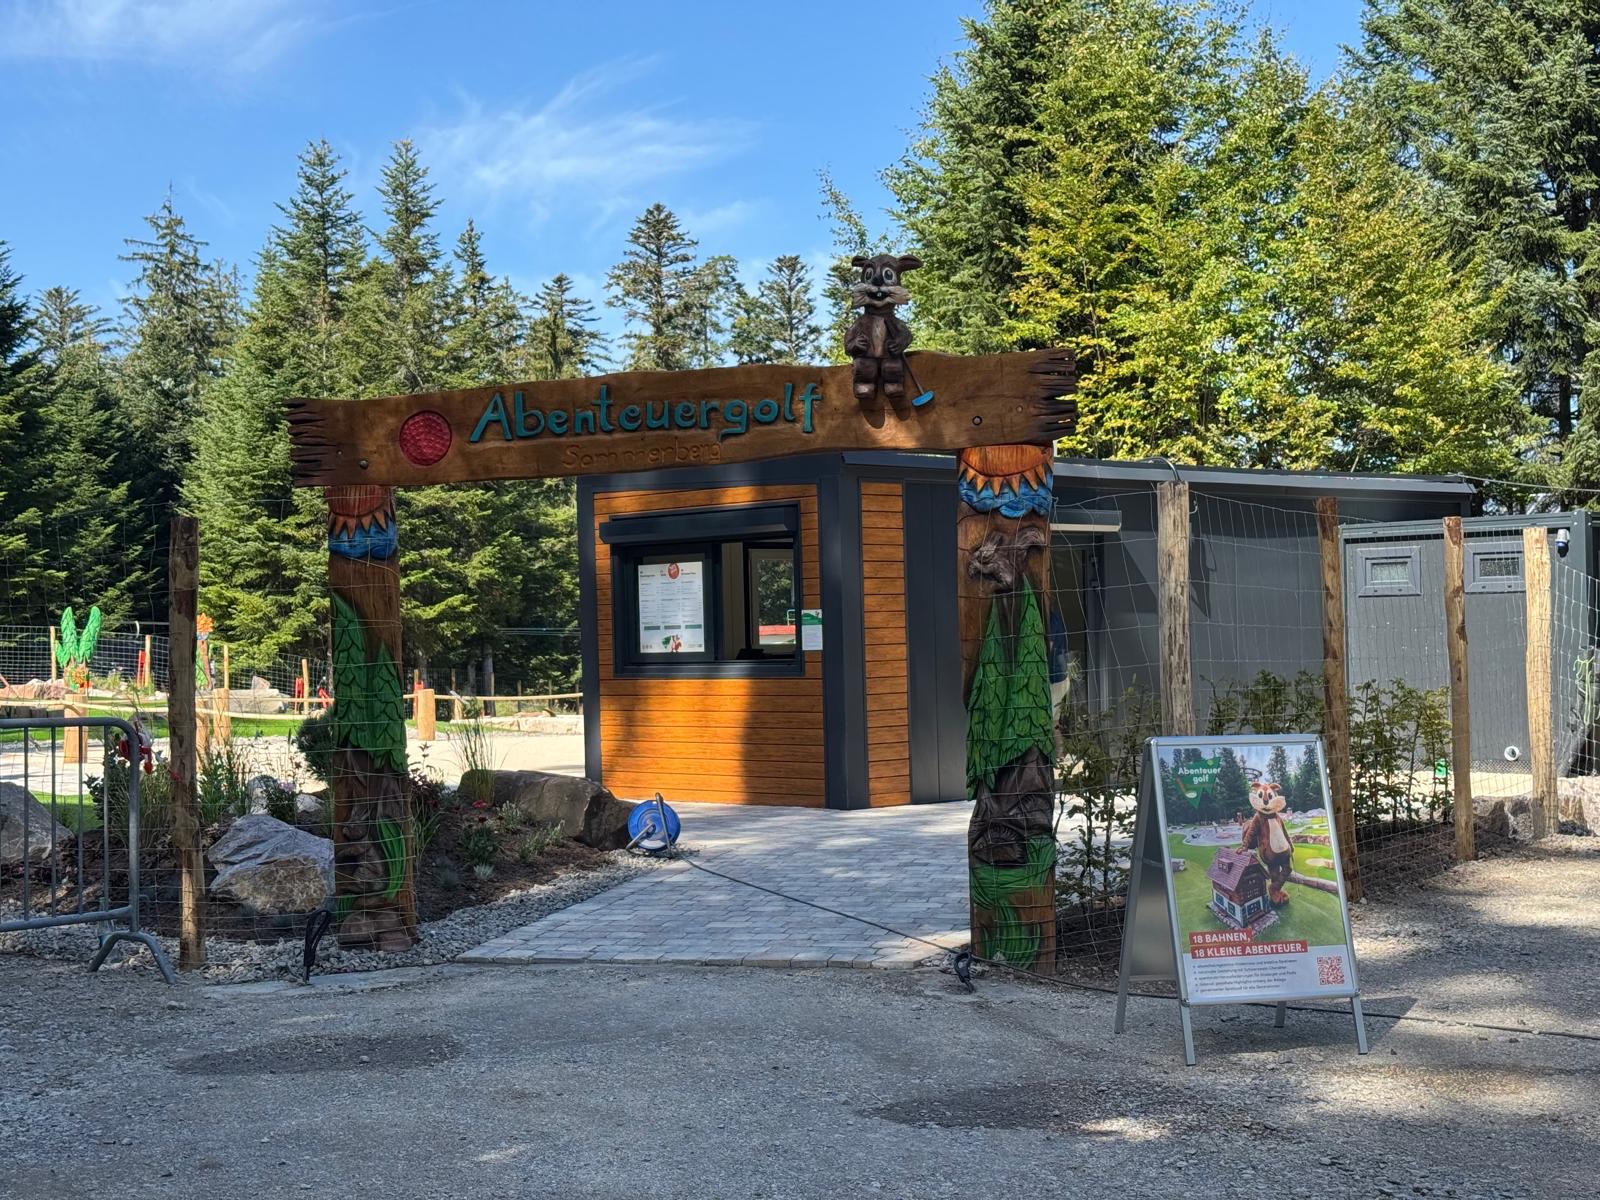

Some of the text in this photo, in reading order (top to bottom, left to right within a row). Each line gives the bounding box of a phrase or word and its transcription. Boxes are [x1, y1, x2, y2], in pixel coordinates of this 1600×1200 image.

[469, 383, 822, 443] Abenteuergolf
[562, 440, 721, 469] Sommerberg
[1178, 767, 1221, 775] Abenteuer
[1192, 775, 1209, 784] golf
[1192, 932, 1251, 944] 18 BAHNEN,
[1194, 943, 1305, 958] 18 KLEINE ABENTEUER.
